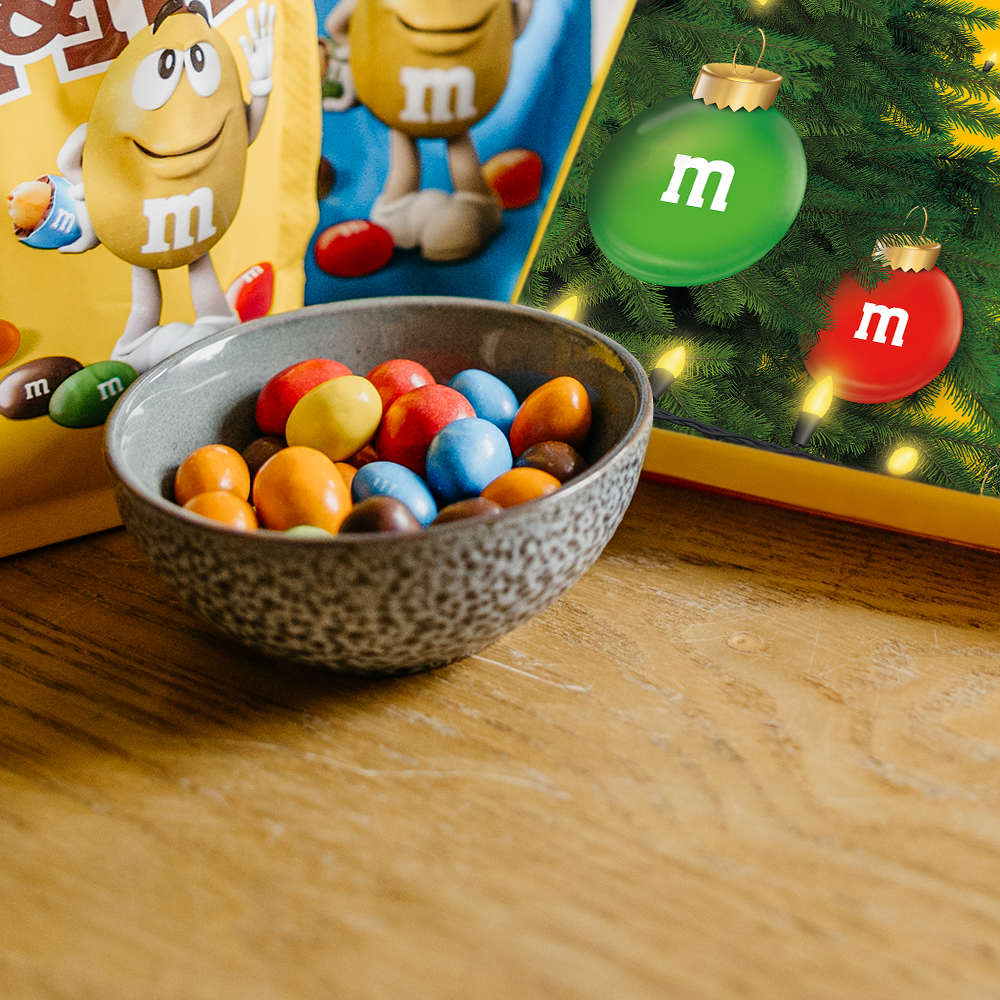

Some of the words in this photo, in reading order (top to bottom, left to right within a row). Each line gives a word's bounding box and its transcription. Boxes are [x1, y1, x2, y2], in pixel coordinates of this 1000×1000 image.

[399, 66, 478, 123] m
[660, 153, 735, 213] m
[52, 207, 76, 234] m
[141, 186, 217, 254] m
[853, 301, 909, 347] m
[25, 378, 50, 400] m
[97, 376, 124, 401] m
